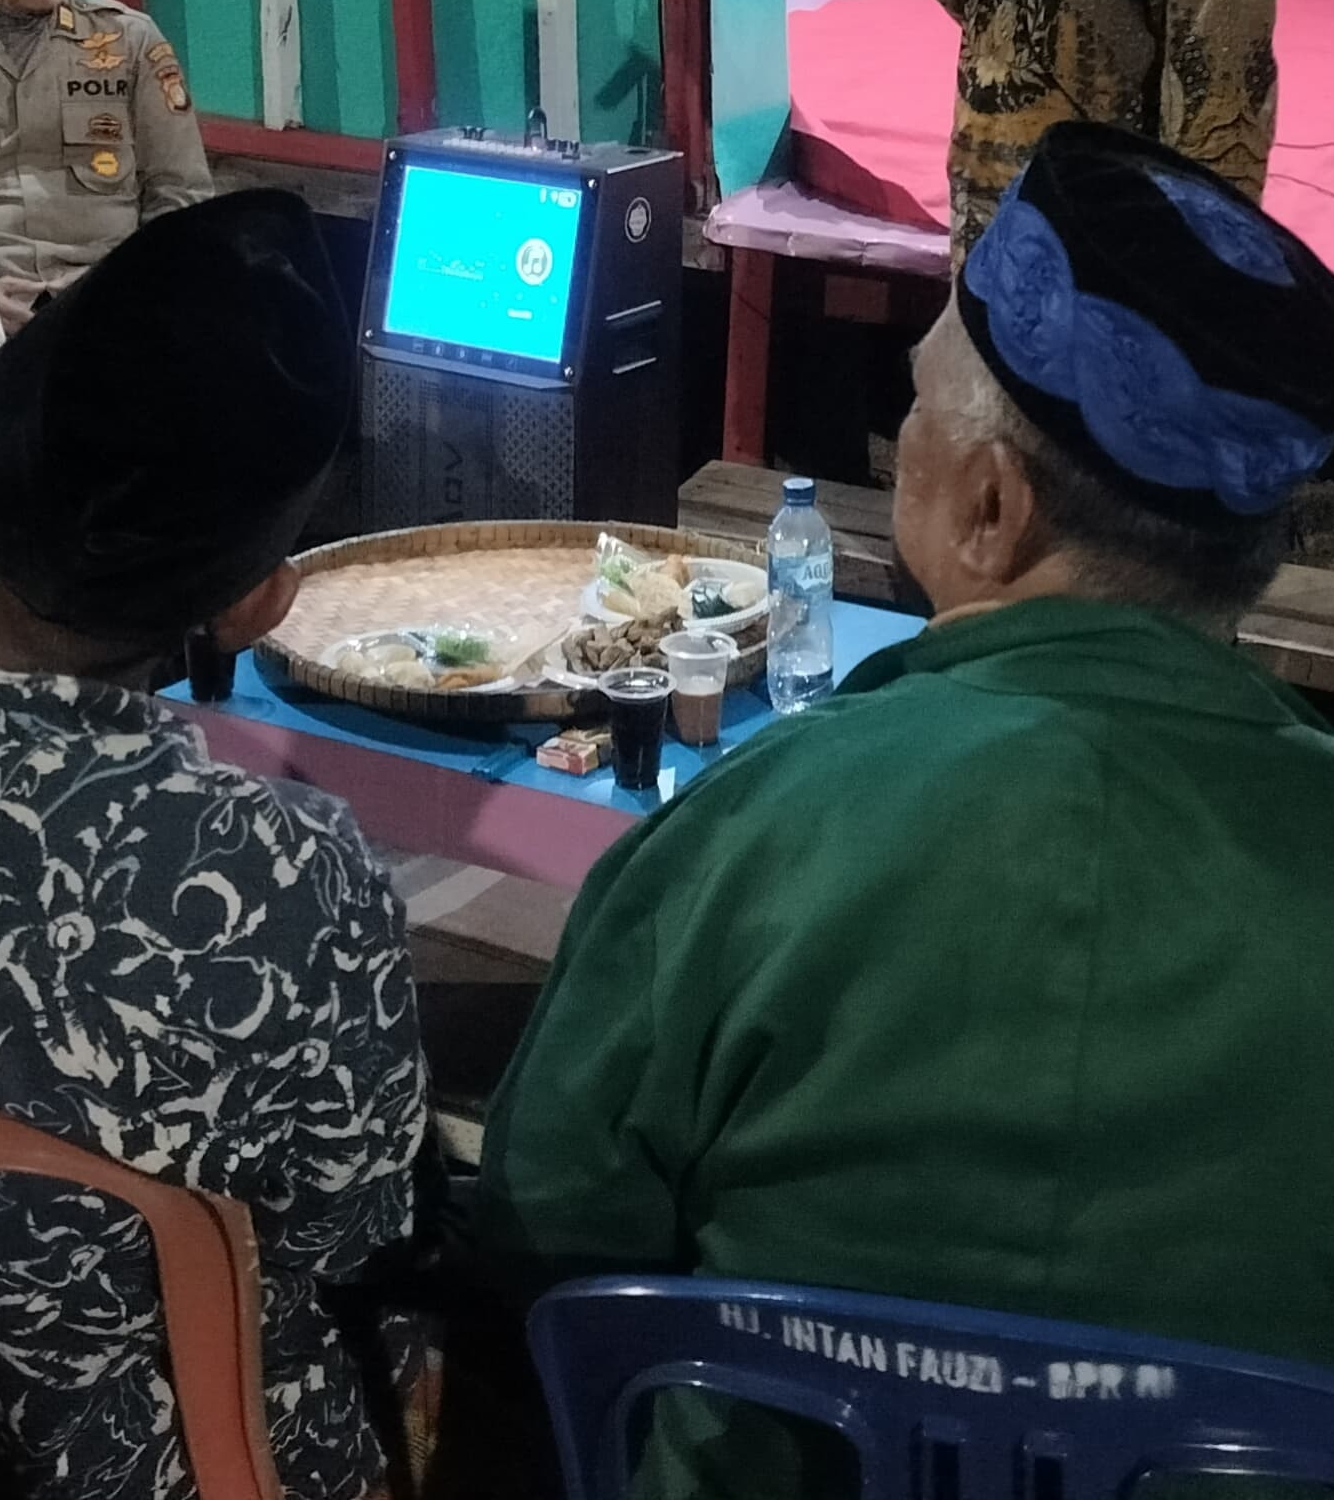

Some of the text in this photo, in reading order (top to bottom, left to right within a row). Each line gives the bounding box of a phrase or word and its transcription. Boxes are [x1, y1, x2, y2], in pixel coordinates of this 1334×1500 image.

[68, 80, 128, 97] POLR
[782, 1314, 887, 1373] INTAN
[896, 1341, 1004, 1395] FAUZI
